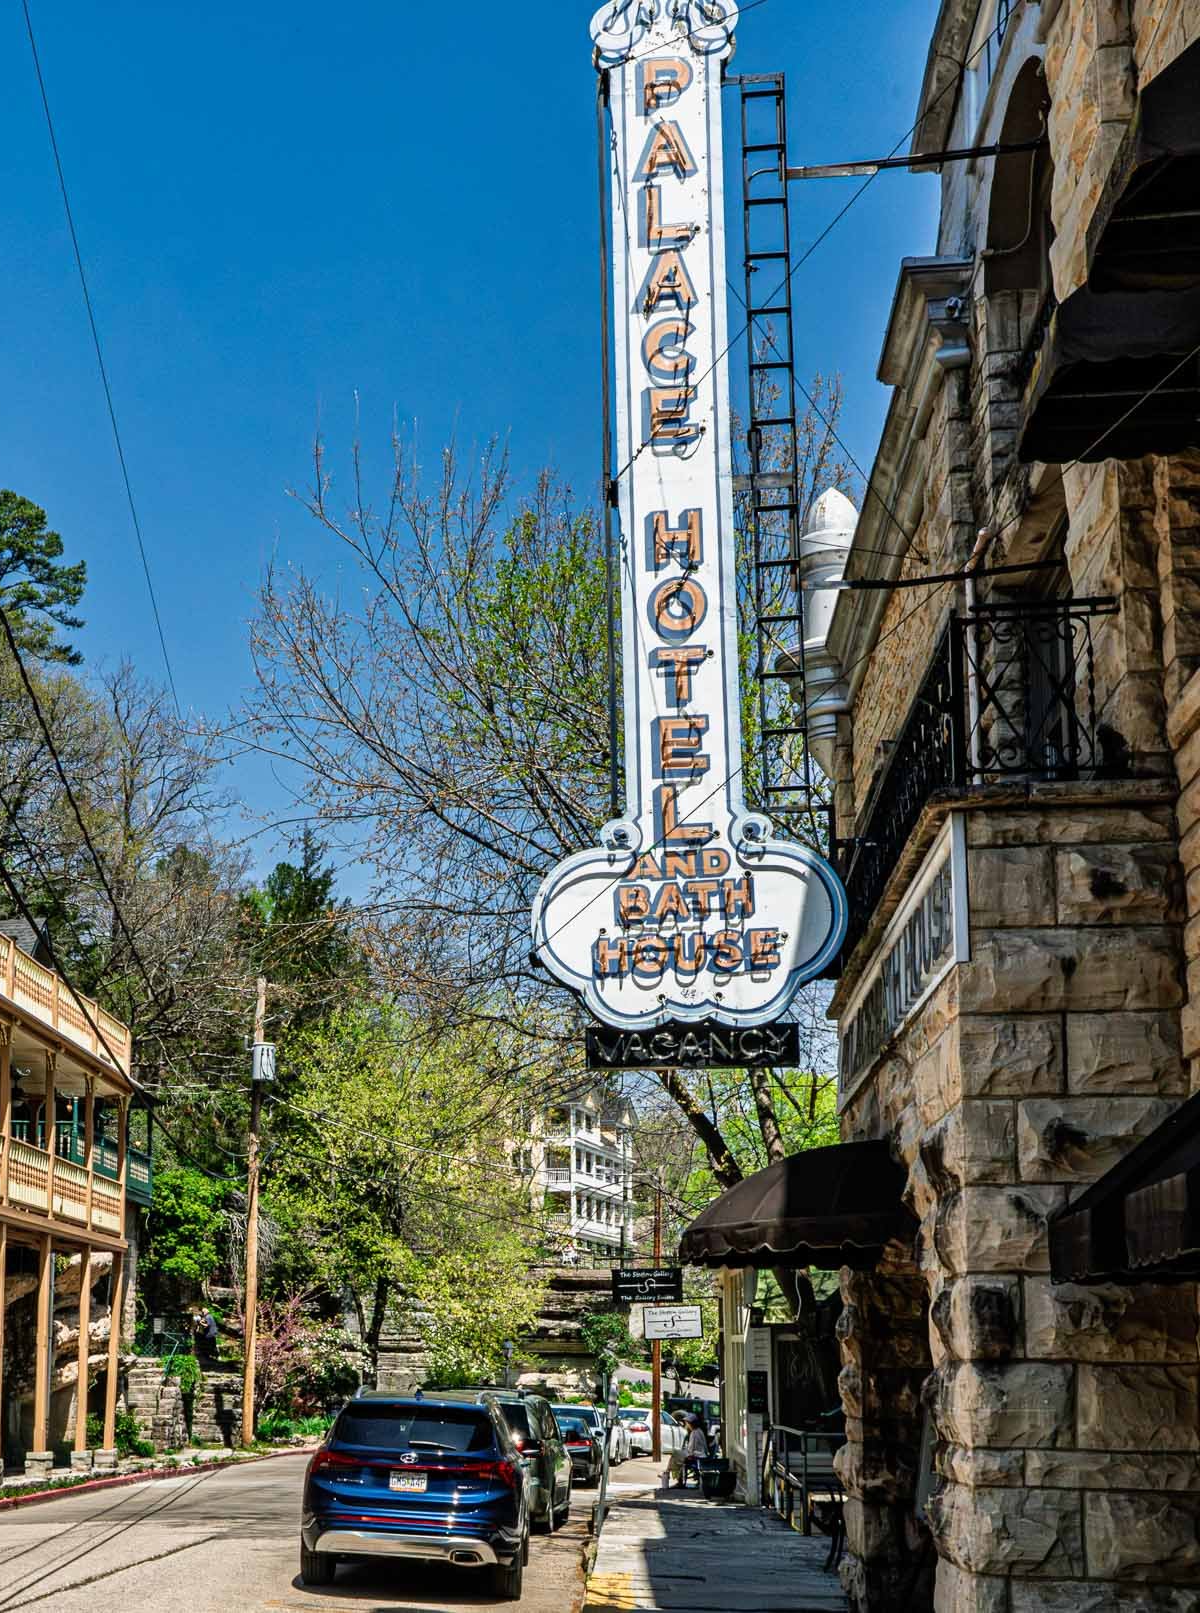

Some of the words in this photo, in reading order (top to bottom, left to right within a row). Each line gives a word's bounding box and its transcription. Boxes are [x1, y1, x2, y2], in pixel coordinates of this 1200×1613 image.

[631, 56, 699, 447] PALACE
[644, 508, 712, 848] HOTEL
[620, 847, 731, 882] AND
[613, 877, 756, 926] BATH
[592, 927, 781, 979] HOUSE
[594, 1029, 791, 1062] VACANCY
